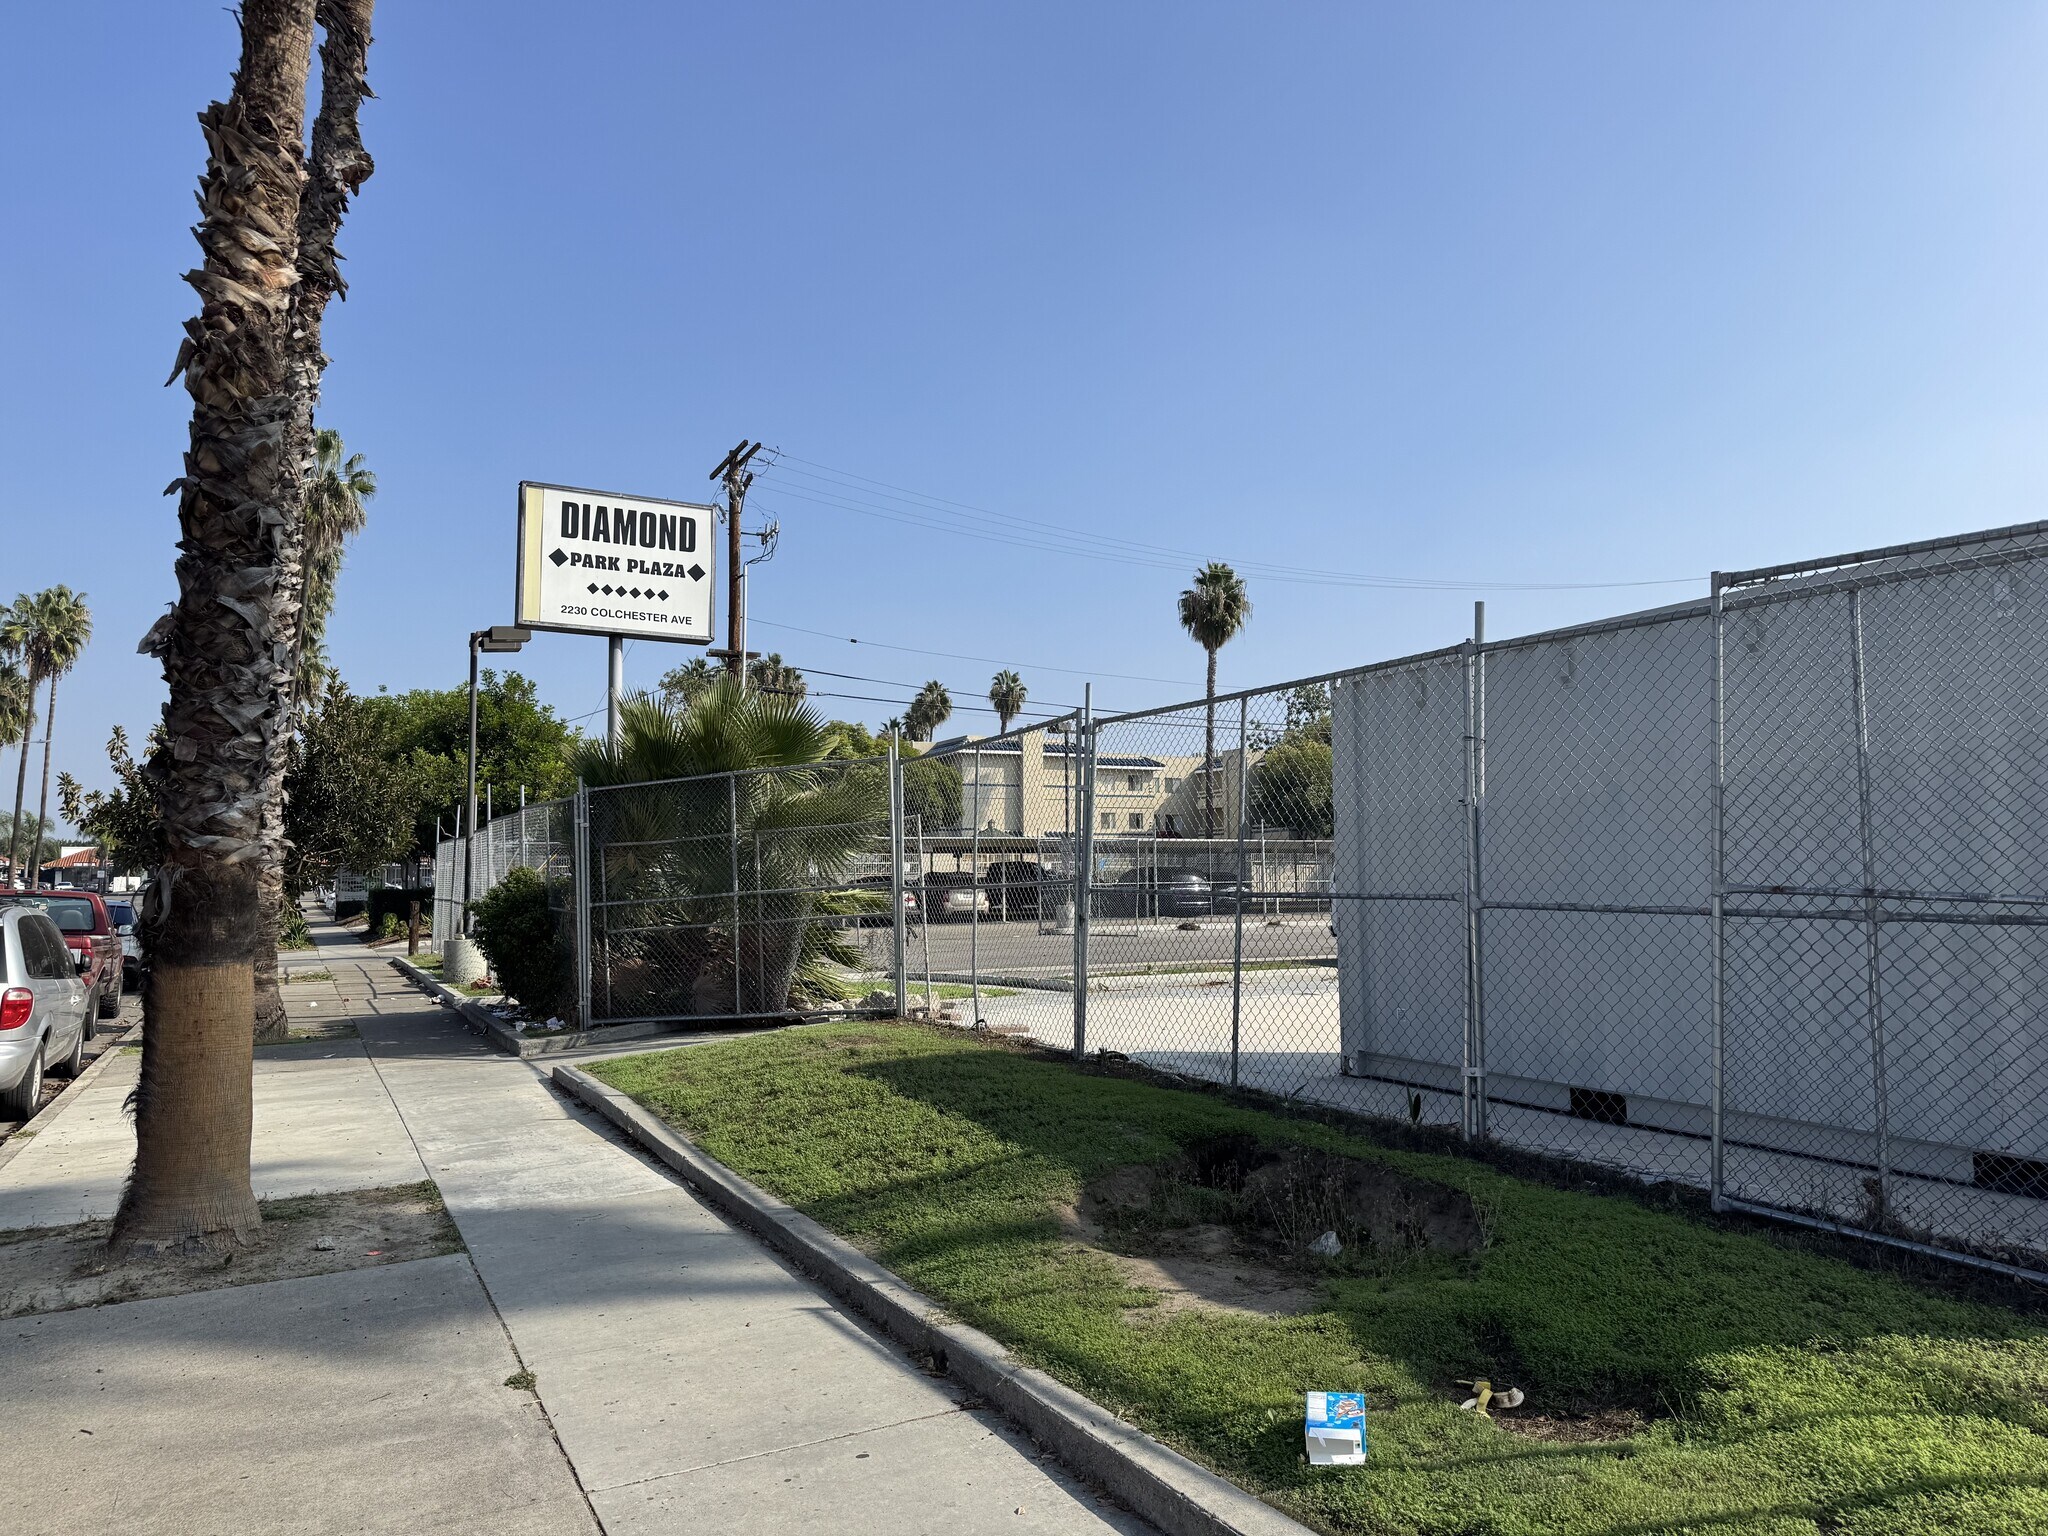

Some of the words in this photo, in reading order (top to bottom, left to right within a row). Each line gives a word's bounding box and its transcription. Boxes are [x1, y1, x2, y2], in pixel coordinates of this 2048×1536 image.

[561, 501, 696, 552] DIAMOND
[570, 552, 619, 571] PARK
[627, 559, 686, 578] PLAZA
[560, 605, 587, 616] 2230
[591, 607, 668, 623] COLCHESTER
[671, 615, 692, 625] AVE
